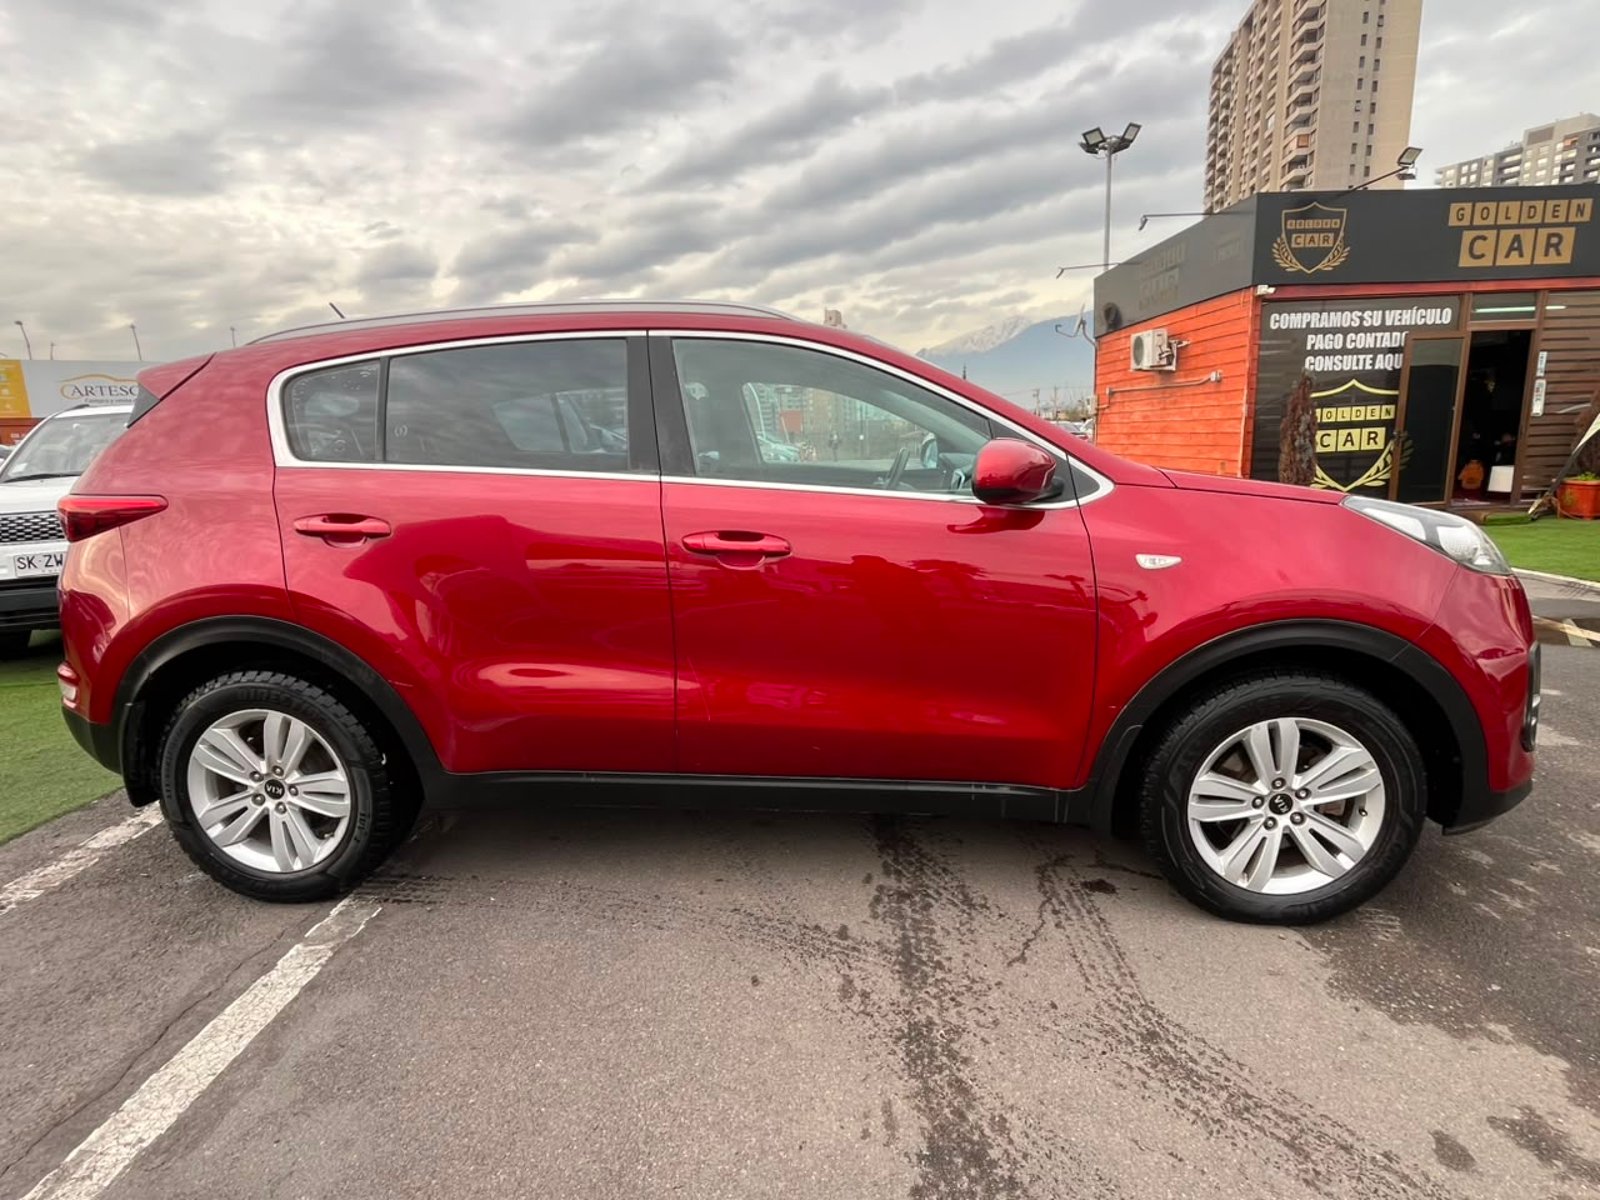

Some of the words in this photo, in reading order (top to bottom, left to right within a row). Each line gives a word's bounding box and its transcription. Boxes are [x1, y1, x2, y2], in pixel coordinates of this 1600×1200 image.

[1454, 202, 1587, 223] GOLDEN
[1294, 234, 1331, 246] CAR
[1467, 231, 1565, 261] CAR
[1269, 311, 1362, 329] COMPRAMOS
[1363, 309, 1382, 327] SU
[1385, 306, 1452, 326] VEHÍCULO
[1306, 333, 1344, 350] PAGO
[1305, 354, 1373, 371] CONSULTE
[1322, 406, 1393, 421] OLDEN
[1319, 430, 1379, 448] CAR
[266, 784, 282, 795] KIA
[1274, 795, 1289, 813] KIA
